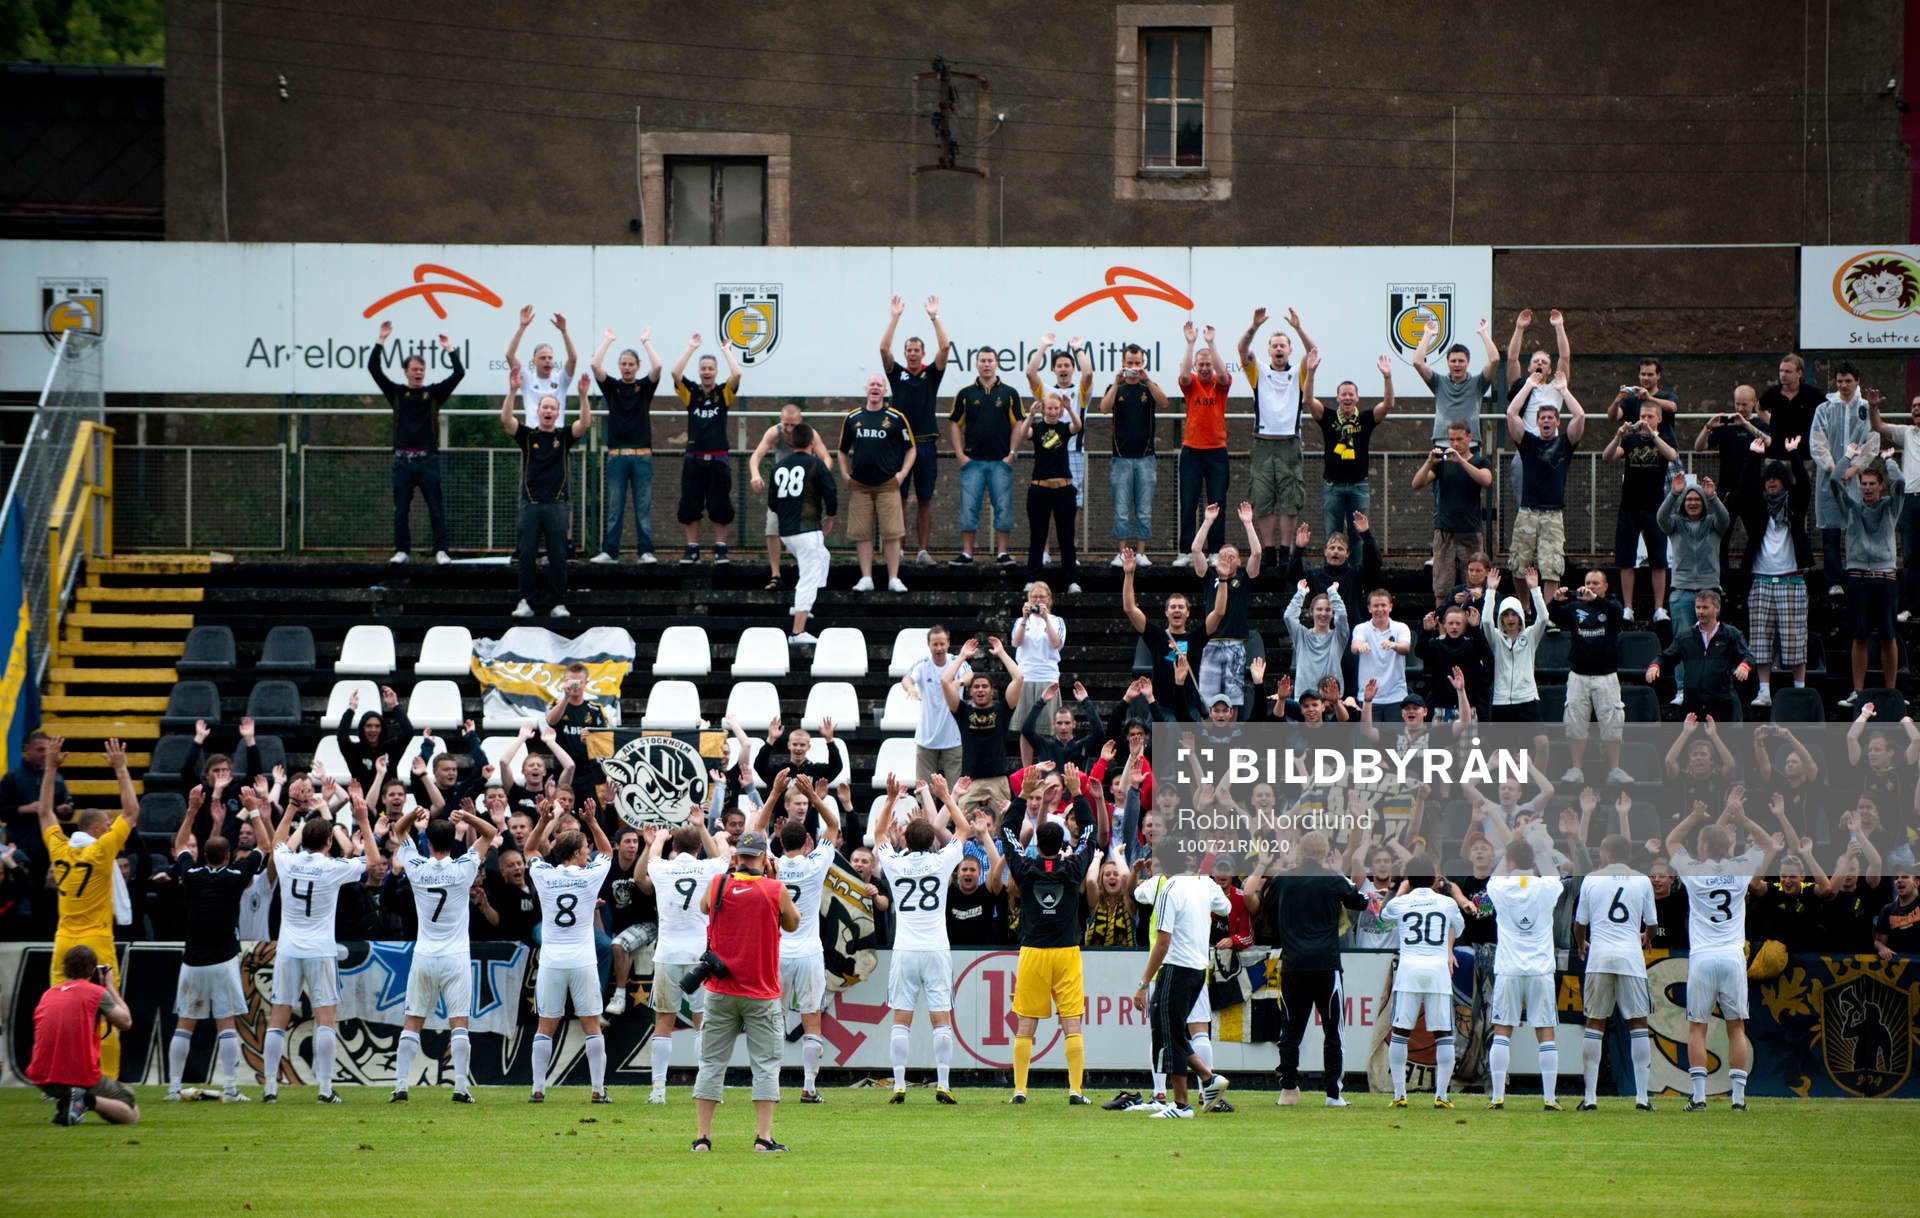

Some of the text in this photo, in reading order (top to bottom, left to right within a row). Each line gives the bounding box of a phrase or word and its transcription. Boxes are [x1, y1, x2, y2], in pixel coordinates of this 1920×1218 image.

[1390, 284, 1452, 293] Jeunesse Esch
[1866, 331, 1910, 343] battre
[640, 737, 693, 754] STOCKHOLM
[55, 859, 93, 898] 27
[675, 877, 697, 912] 9
[895, 876, 941, 912] 28
[292, 879, 314, 918] 4
[427, 887, 448, 923] 7
[554, 893, 579, 928] 8
[1608, 886, 1630, 924] 6
[1709, 889, 1733, 924] 3
[1402, 911, 1447, 946] 30
